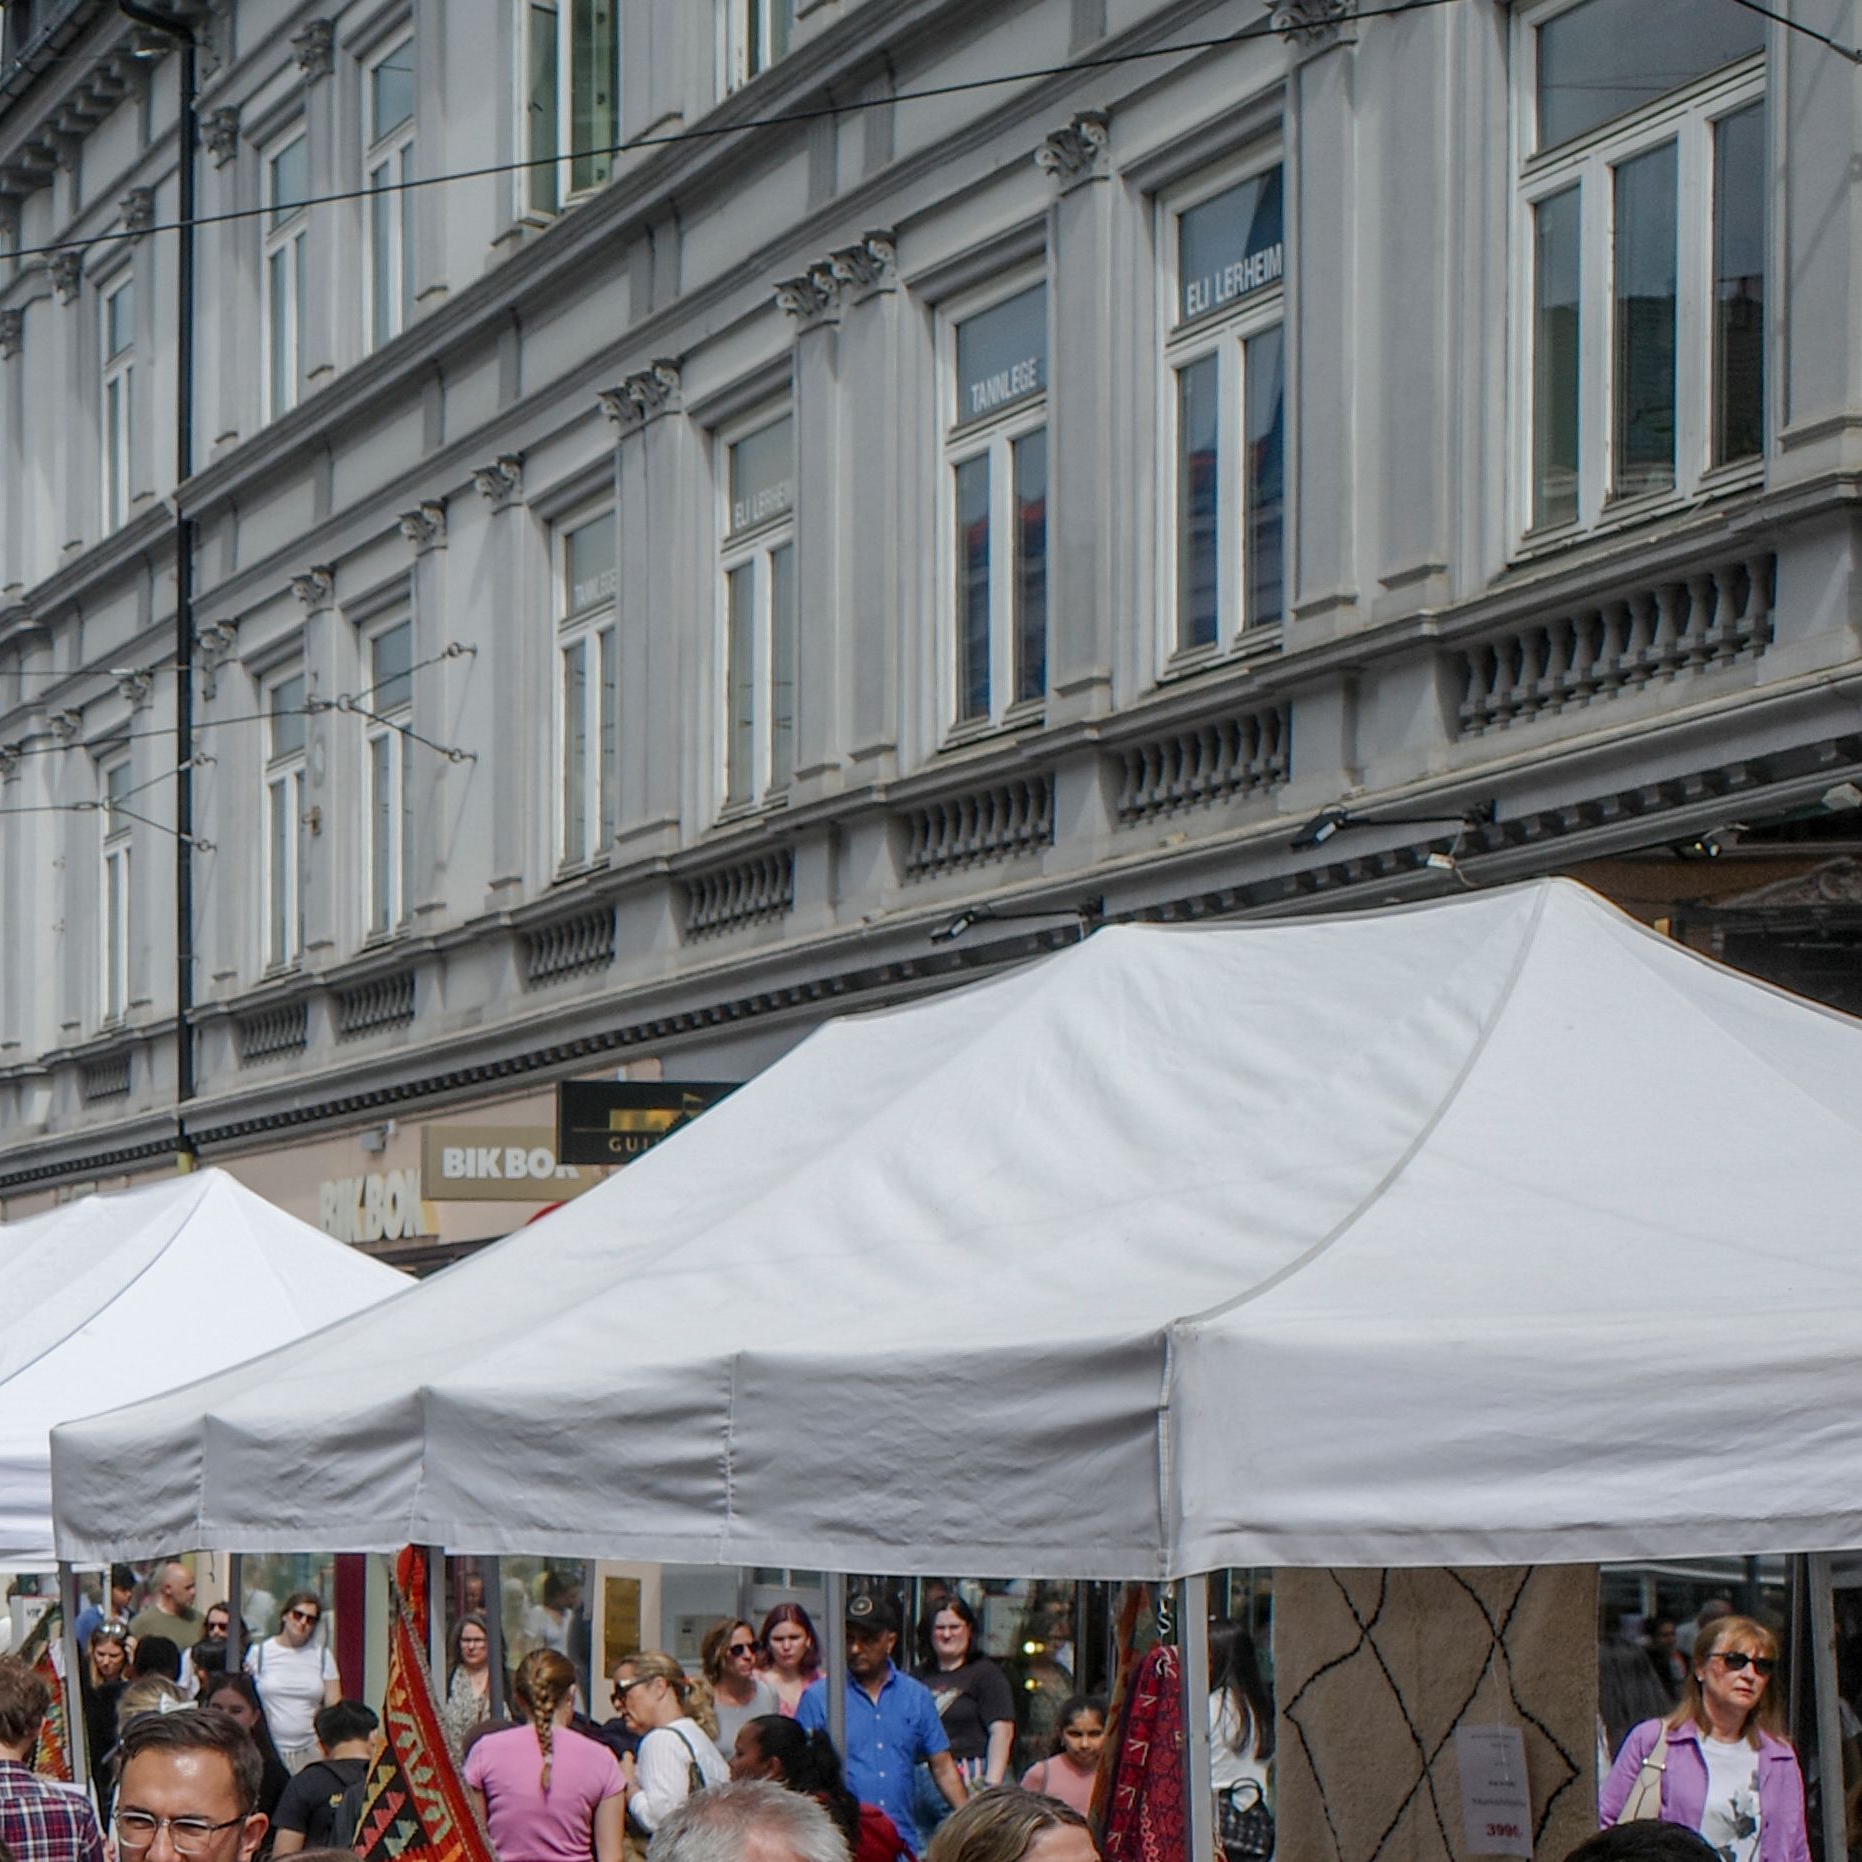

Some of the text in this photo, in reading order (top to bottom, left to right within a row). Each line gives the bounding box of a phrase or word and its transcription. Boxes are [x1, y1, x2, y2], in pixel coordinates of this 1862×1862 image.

[1186, 243, 1283, 316] ELI LERHEIM
[971, 358, 1038, 412] TANNLEGE
[442, 1147, 501, 1180] BIK
